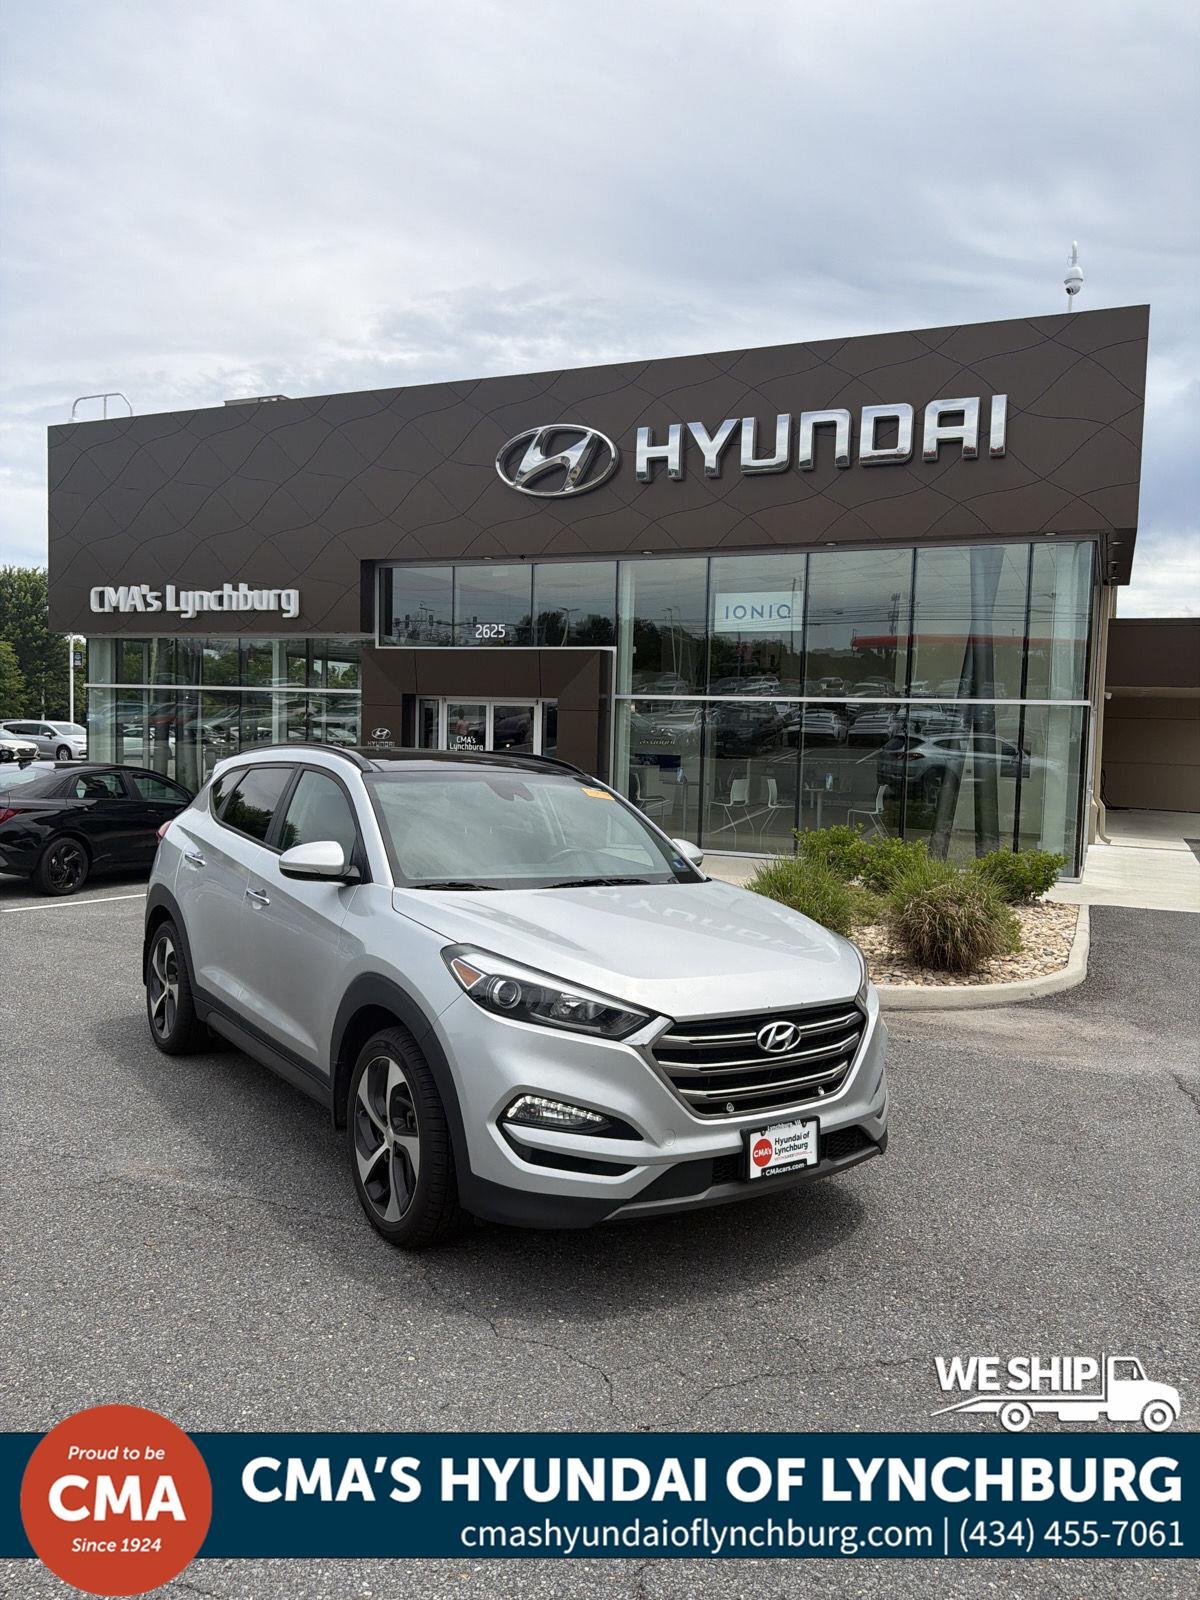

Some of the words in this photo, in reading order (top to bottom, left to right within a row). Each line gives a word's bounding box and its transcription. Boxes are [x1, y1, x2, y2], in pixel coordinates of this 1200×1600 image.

[636, 394, 1008, 482] HYUNDAI
[90, 584, 162, 613] CMA's
[166, 583, 300, 618] Lynchburg
[724, 603, 792, 620] IONIQ
[475, 624, 506, 638] 2625
[449, 742, 484, 751] Lynchburg
[774, 1133, 801, 1145] Hyundai
[802, 1131, 810, 1140] of
[774, 1142, 808, 1156] Lynchburg
[765, 1163, 804, 1176] CMAcars.com
